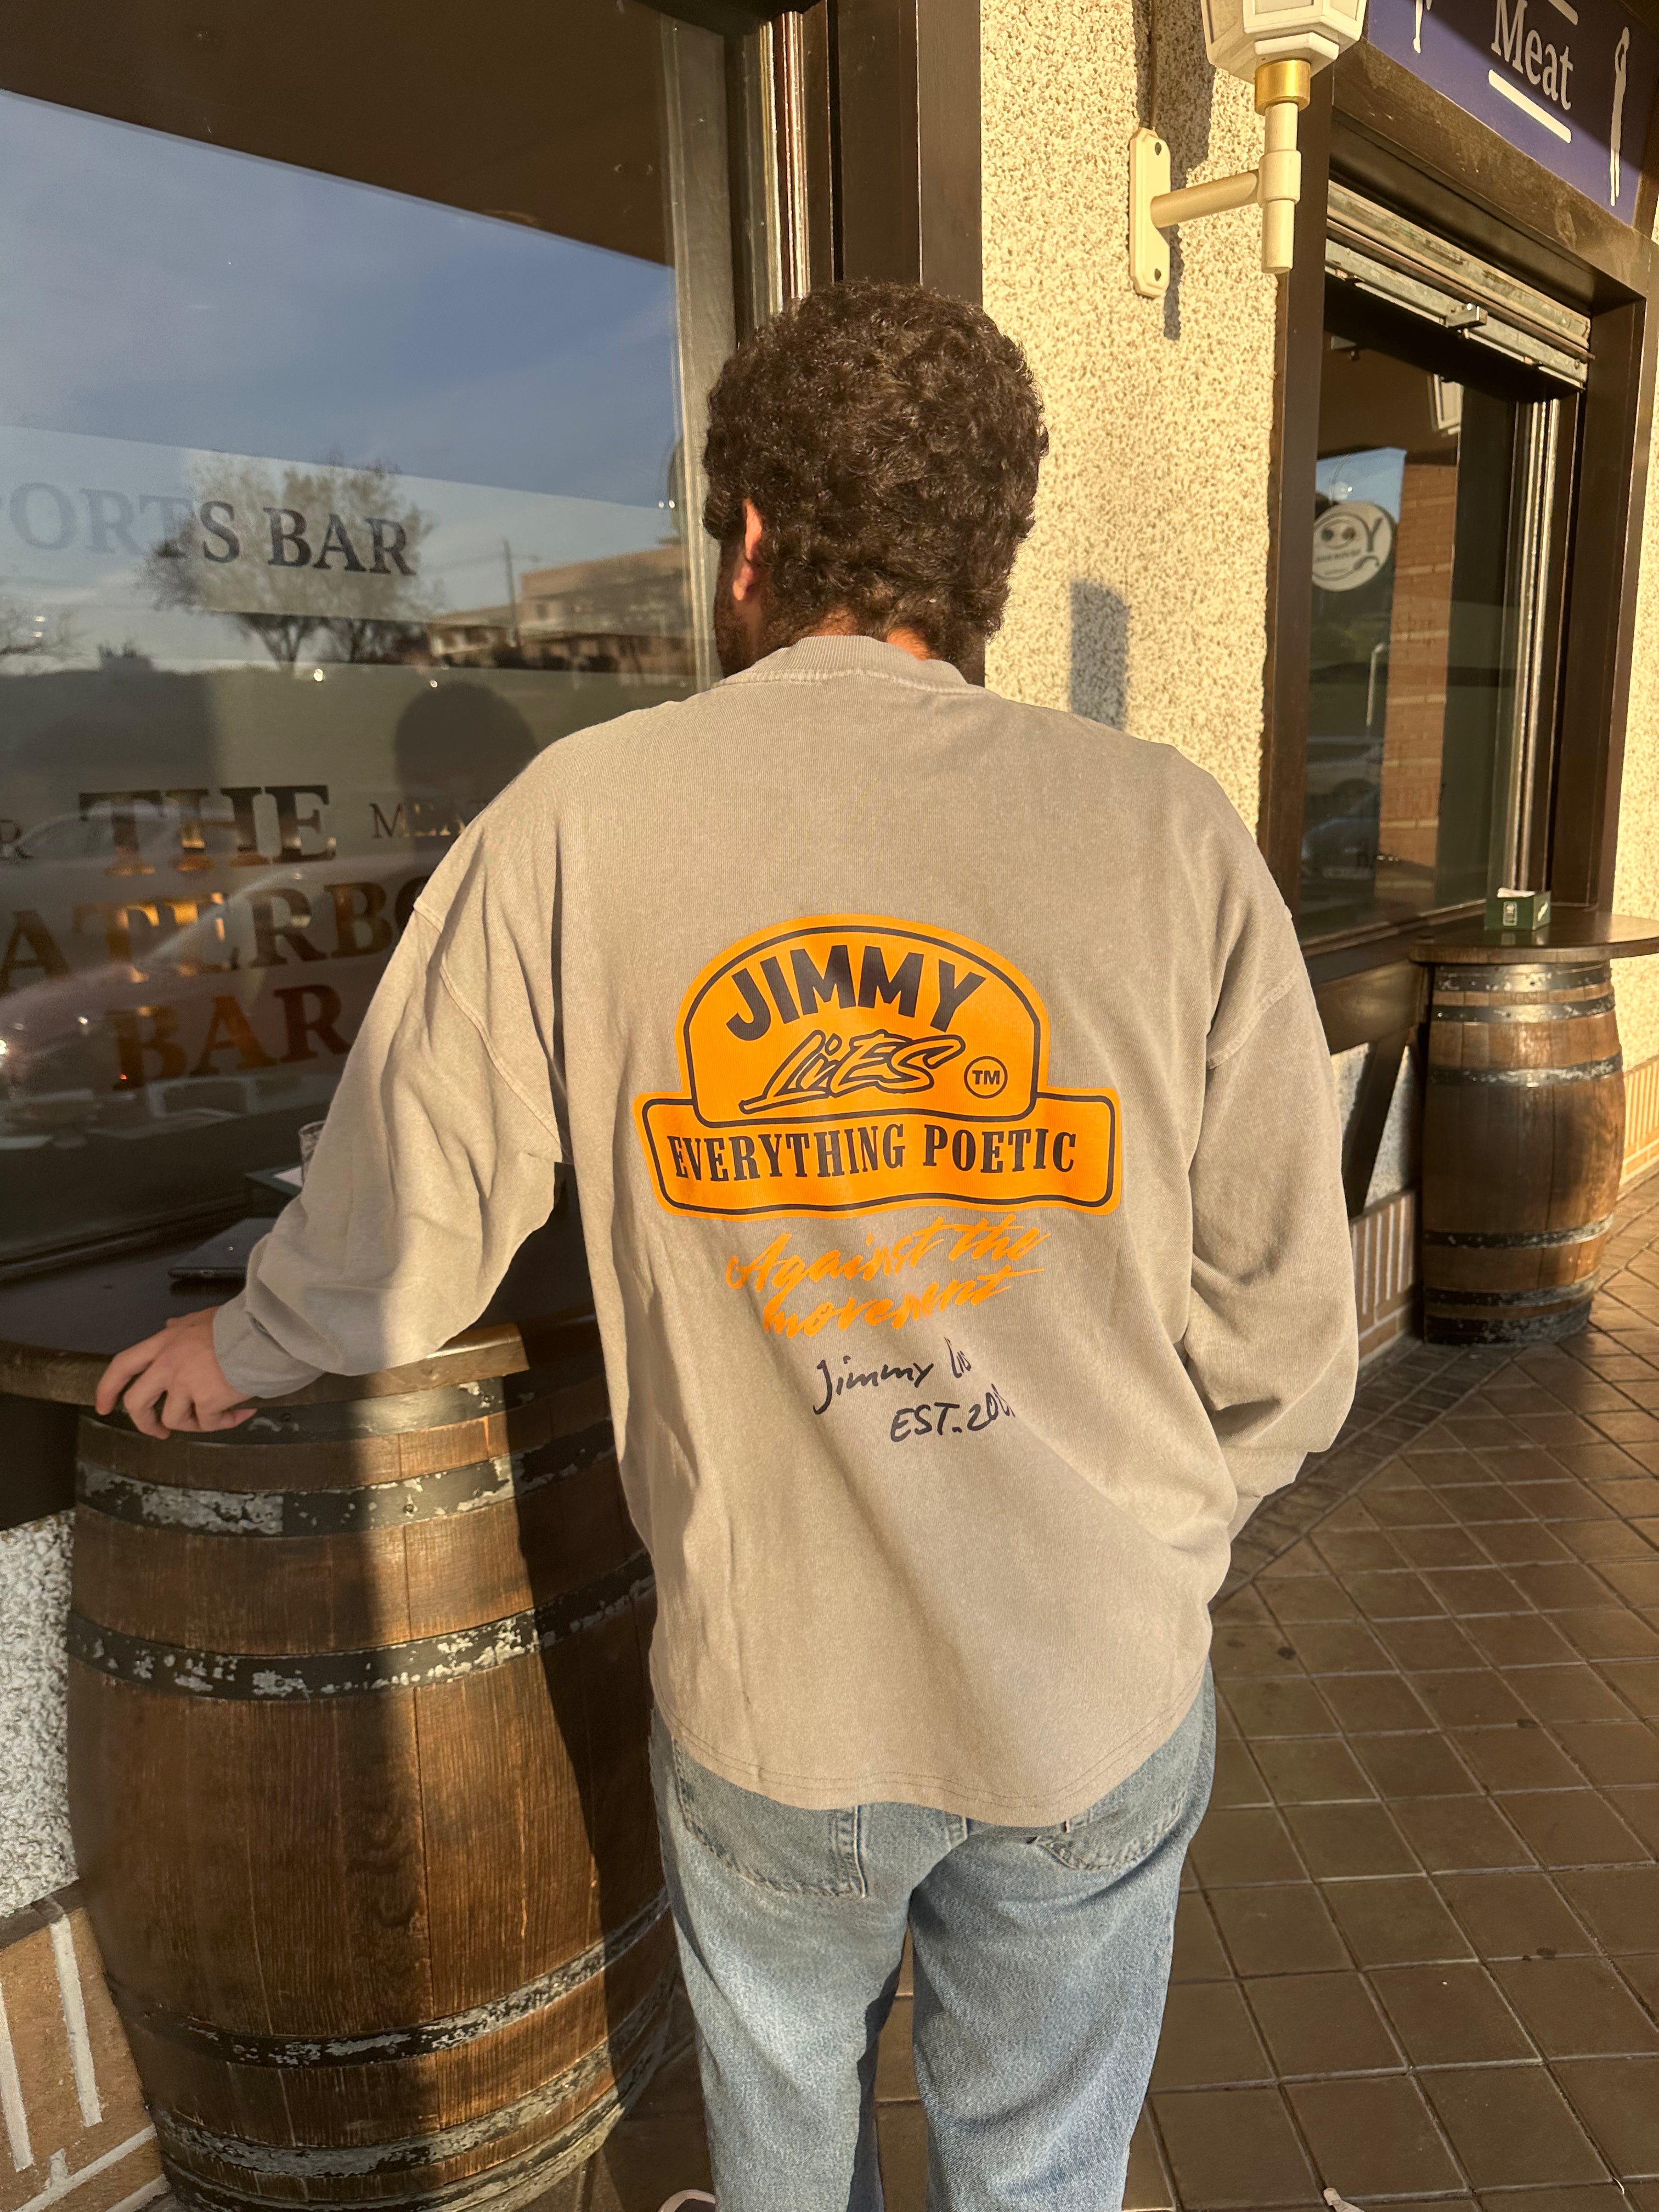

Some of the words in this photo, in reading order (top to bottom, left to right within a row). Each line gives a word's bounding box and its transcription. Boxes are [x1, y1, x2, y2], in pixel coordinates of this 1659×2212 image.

[1491, 0, 1573, 110] Meat
[0, 482, 240, 564] ORTS
[263, 507, 417, 576] BAR
[79, 785, 336, 875] THE
[107, 985, 353, 1090] BAR
[726, 944, 986, 1041] JIMMY
[667, 1124, 904, 1182] EVERYTHING
[923, 1124, 1076, 1173] POETIC
[725, 1215, 945, 1301] Against
[948, 1214, 1052, 1261] the
[812, 1355, 934, 1415] Jimmy
